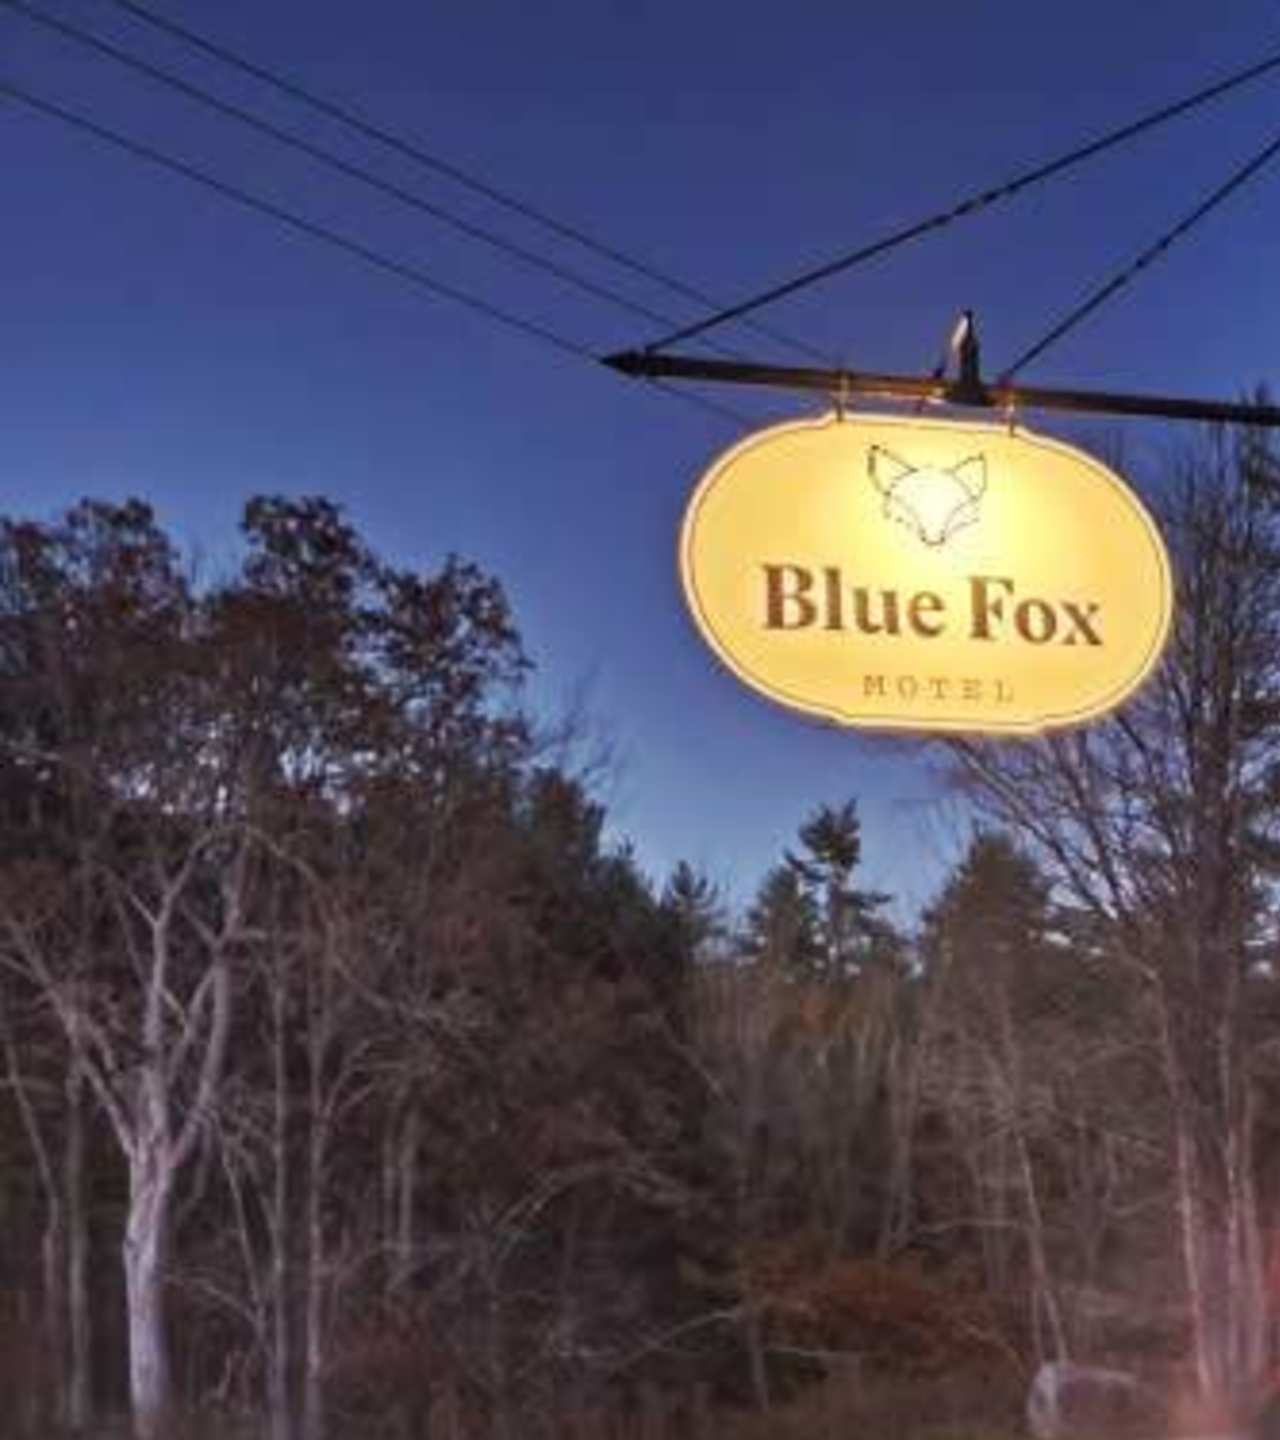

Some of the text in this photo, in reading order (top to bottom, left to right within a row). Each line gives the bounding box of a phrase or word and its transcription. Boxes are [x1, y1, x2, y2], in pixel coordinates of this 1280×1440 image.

[760, 563, 1103, 647] Blue Fox
[863, 674, 1015, 703] MOTEL
